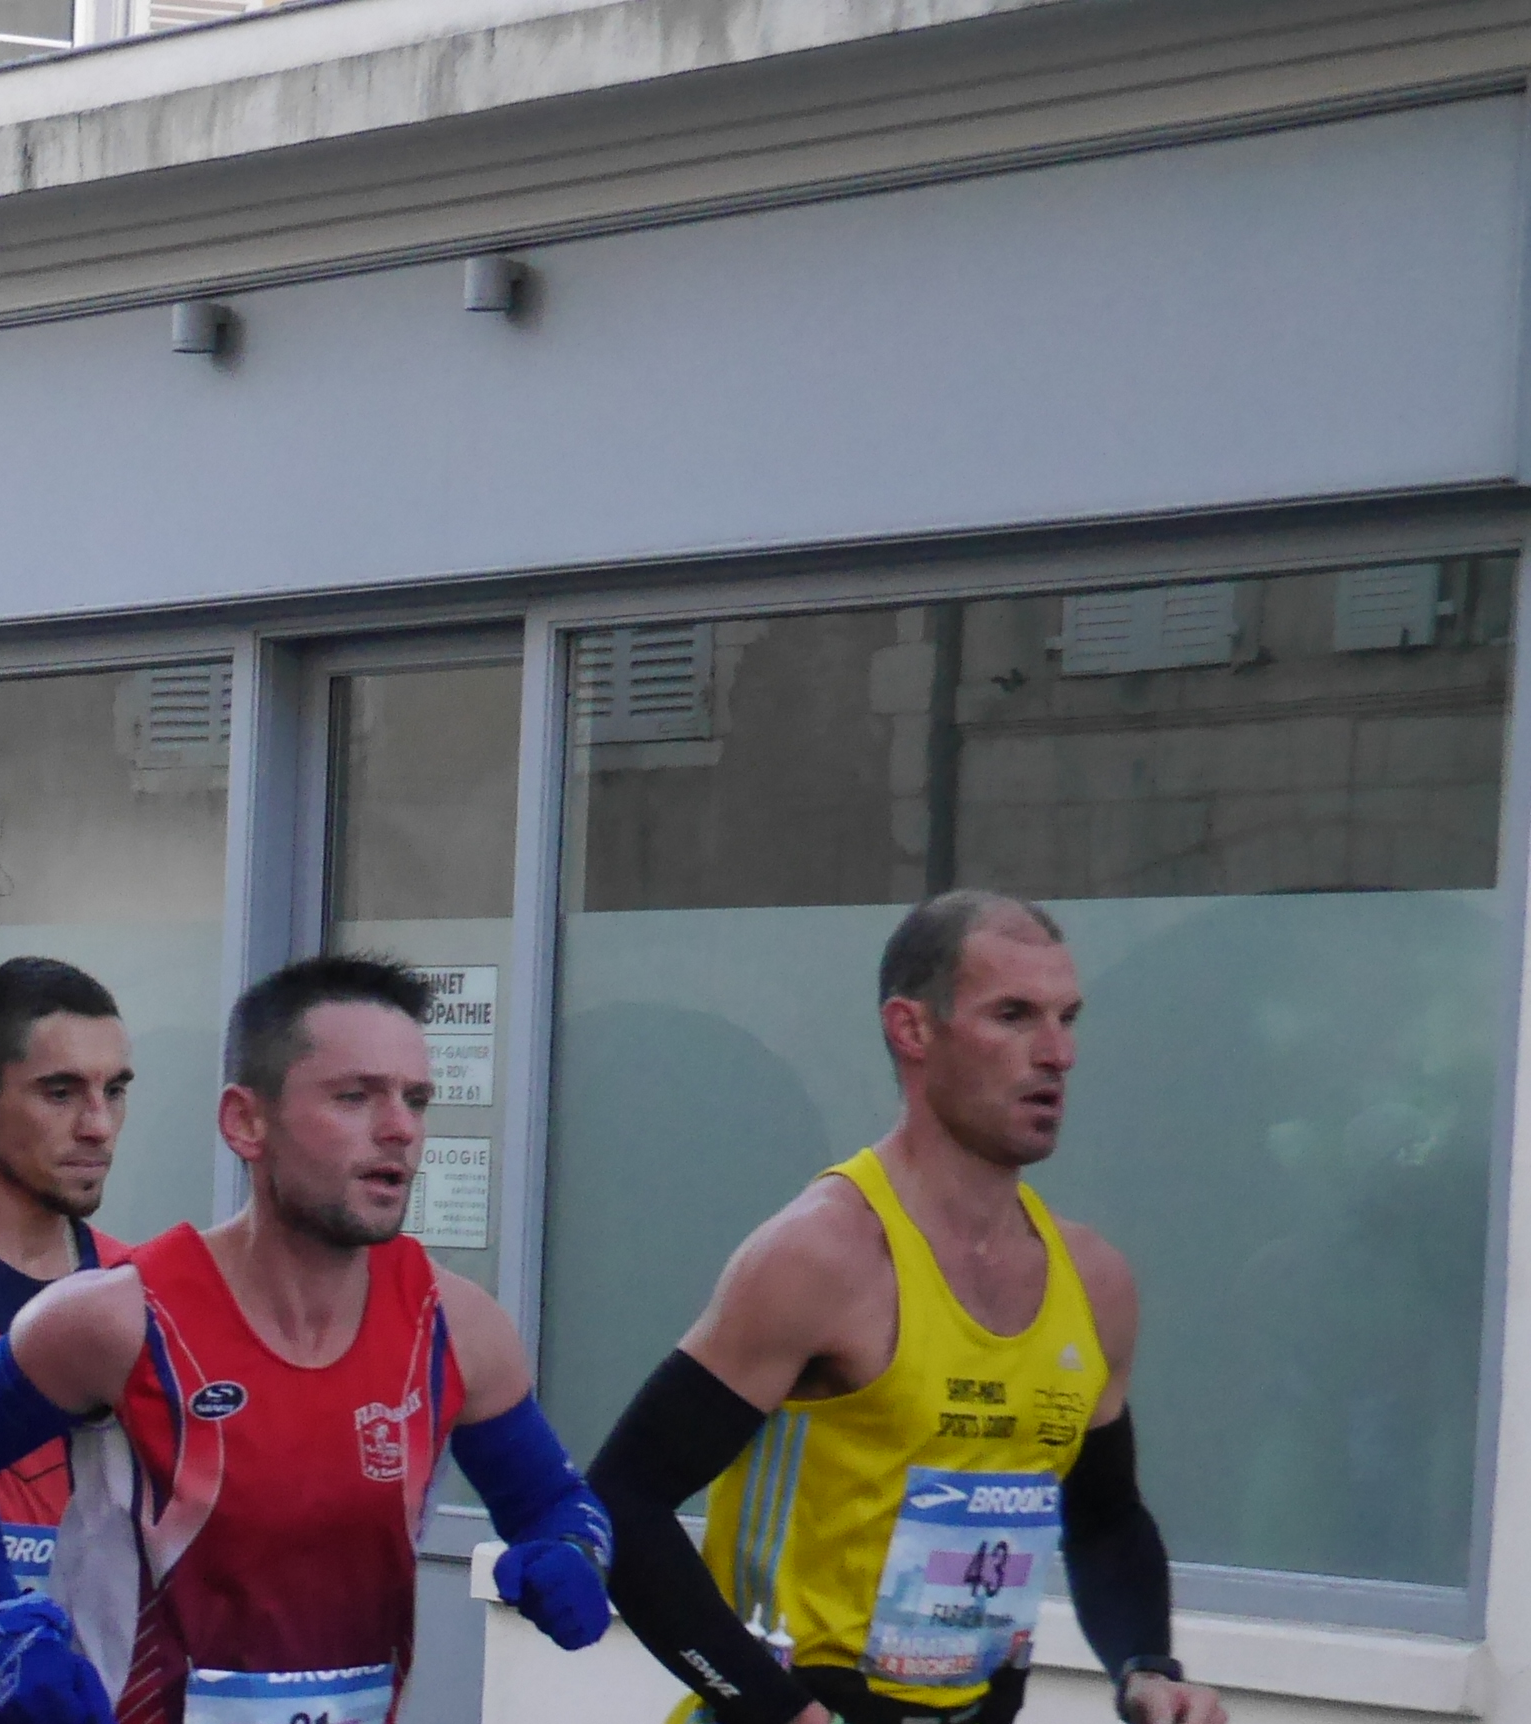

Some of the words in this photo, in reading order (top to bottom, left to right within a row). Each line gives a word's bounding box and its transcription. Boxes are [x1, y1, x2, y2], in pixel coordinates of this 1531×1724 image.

[448, 1085, 463, 1100] 22
[466, 1085, 480, 1100] 61
[966, 1484, 1057, 1515] BROOKS
[963, 1540, 1009, 1598] 43
